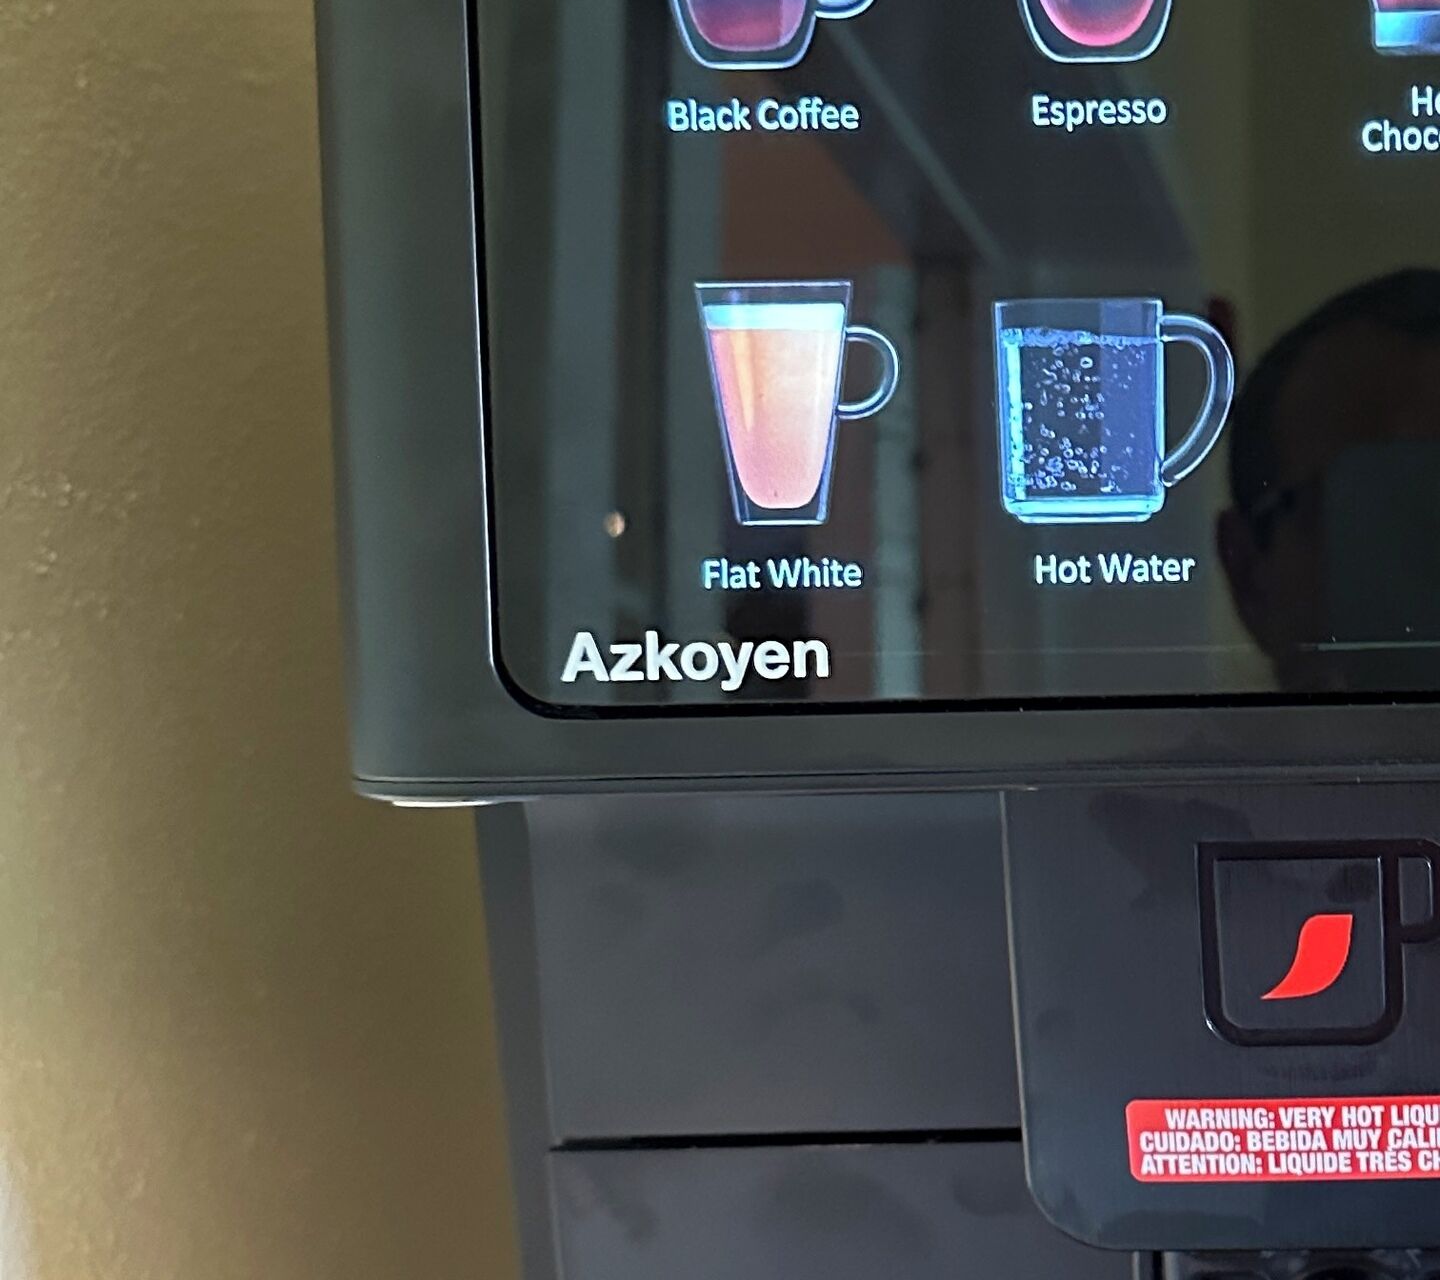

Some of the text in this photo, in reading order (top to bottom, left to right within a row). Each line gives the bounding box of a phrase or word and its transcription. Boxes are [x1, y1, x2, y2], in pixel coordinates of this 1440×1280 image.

[667, 96, 860, 132] Black Coffee
[1031, 94, 1167, 132] Espresso
[703, 557, 863, 589] Flat White
[1035, 552, 1197, 584] Hot Water
[561, 631, 831, 691] Azkoyen
[1165, 1106, 1275, 1130] WARNING:
[1279, 1106, 1334, 1129] VERY
[1341, 1105, 1385, 1127] HOT
[1139, 1130, 1242, 1154] CUIDADO:
[1247, 1130, 1326, 1152] BEBIDA
[1333, 1129, 1382, 1150] MUY
[1141, 1153, 1264, 1176] ATTENTION:
[1269, 1152, 1352, 1175] LIQUIDE
